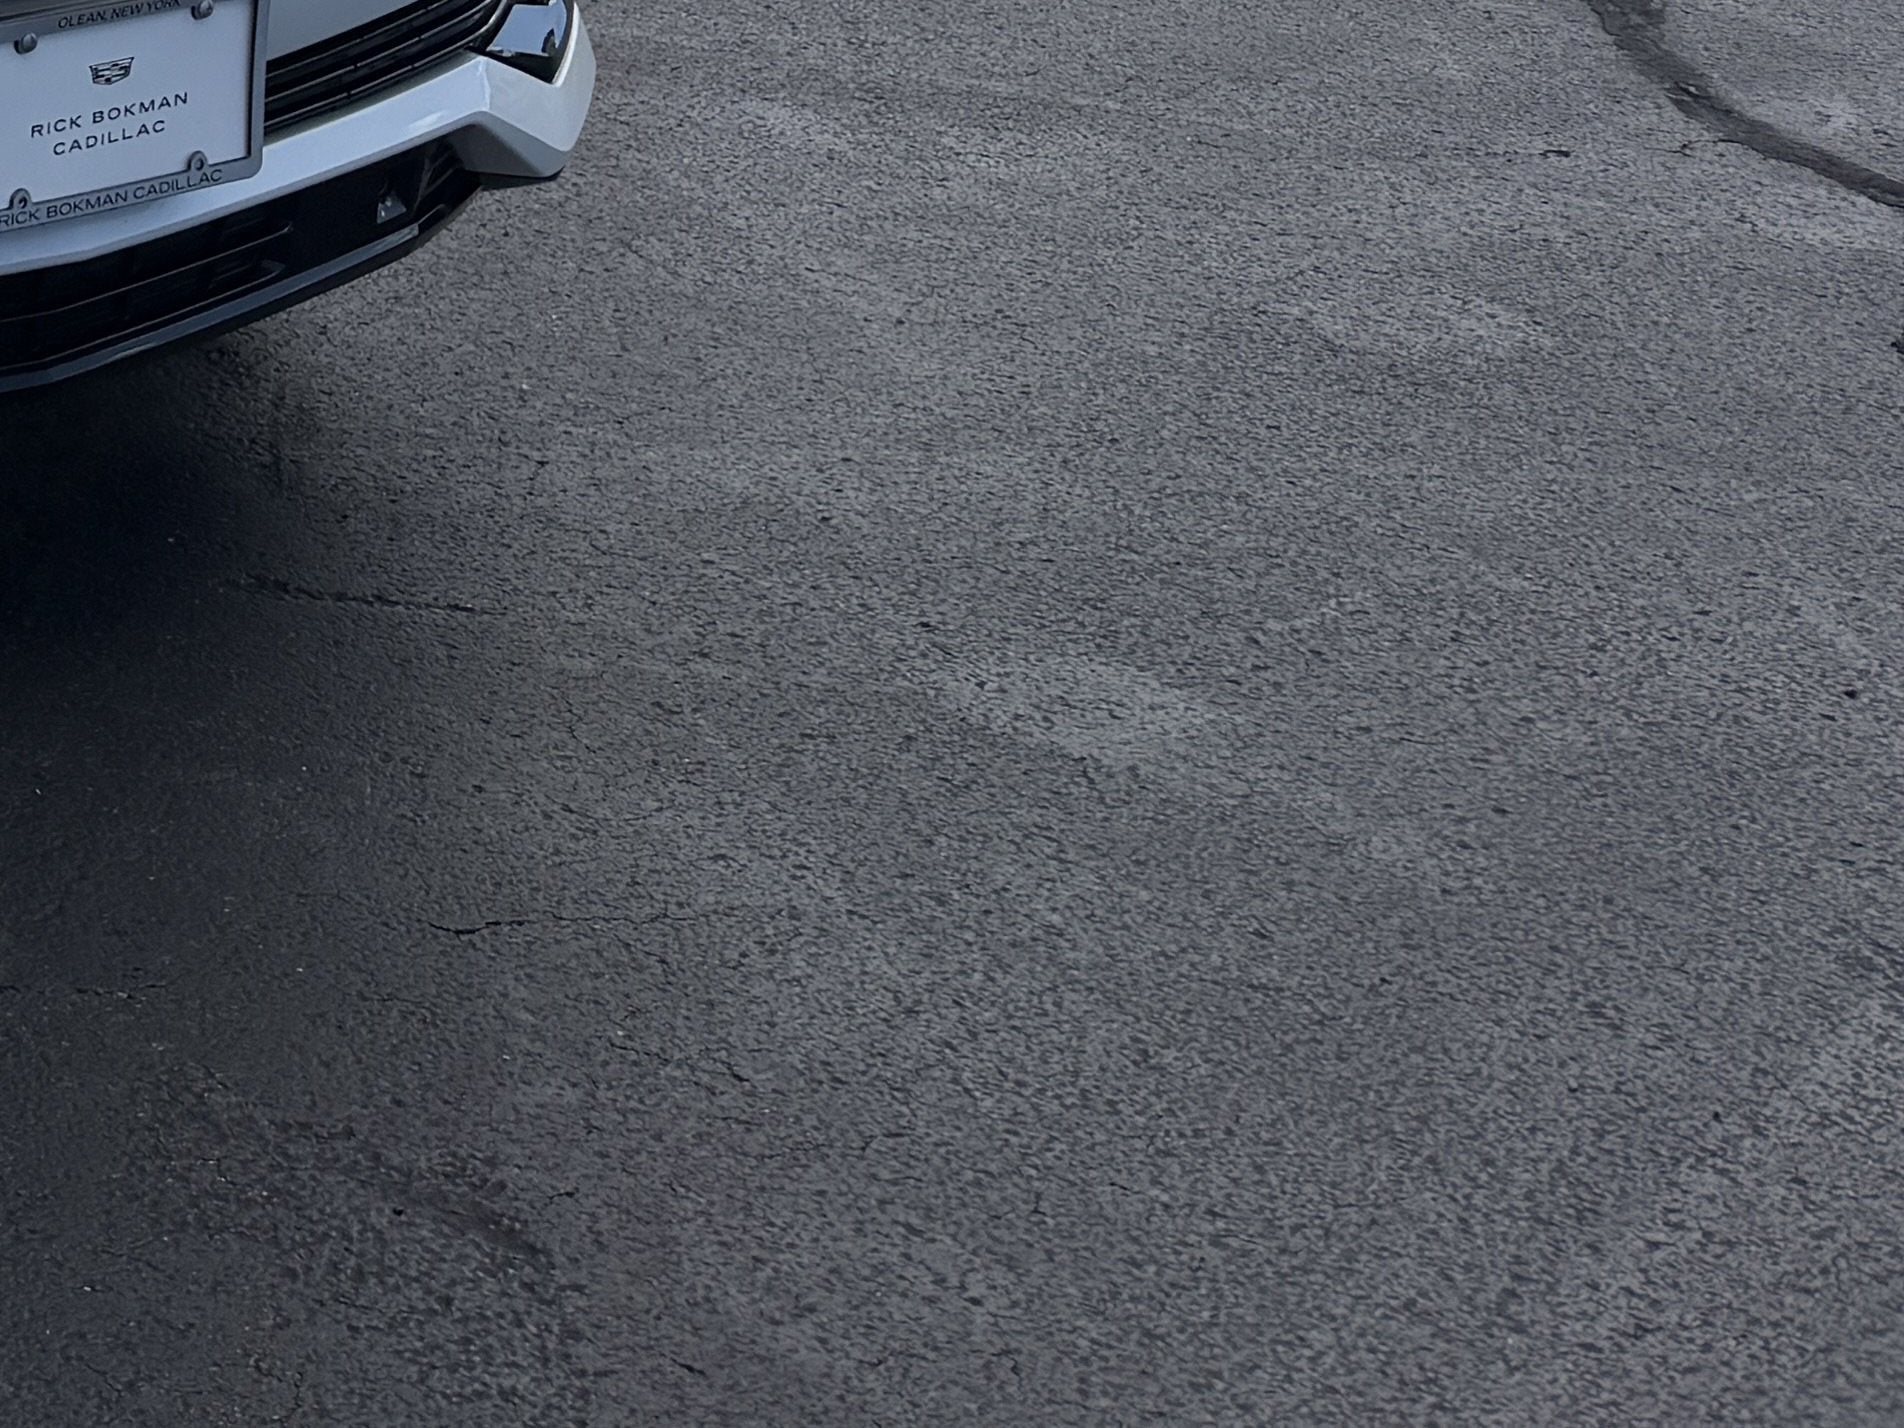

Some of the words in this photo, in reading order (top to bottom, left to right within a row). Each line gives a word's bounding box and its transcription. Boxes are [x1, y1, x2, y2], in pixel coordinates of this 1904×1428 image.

[111, 3, 143, 20] NEW
[30, 115, 82, 138] RICK
[92, 92, 188, 124] BOKMAN
[53, 120, 165, 156] CADILLAC
[46, 191, 128, 218] BOKMAN
[133, 169, 223, 199] CADILLAC
